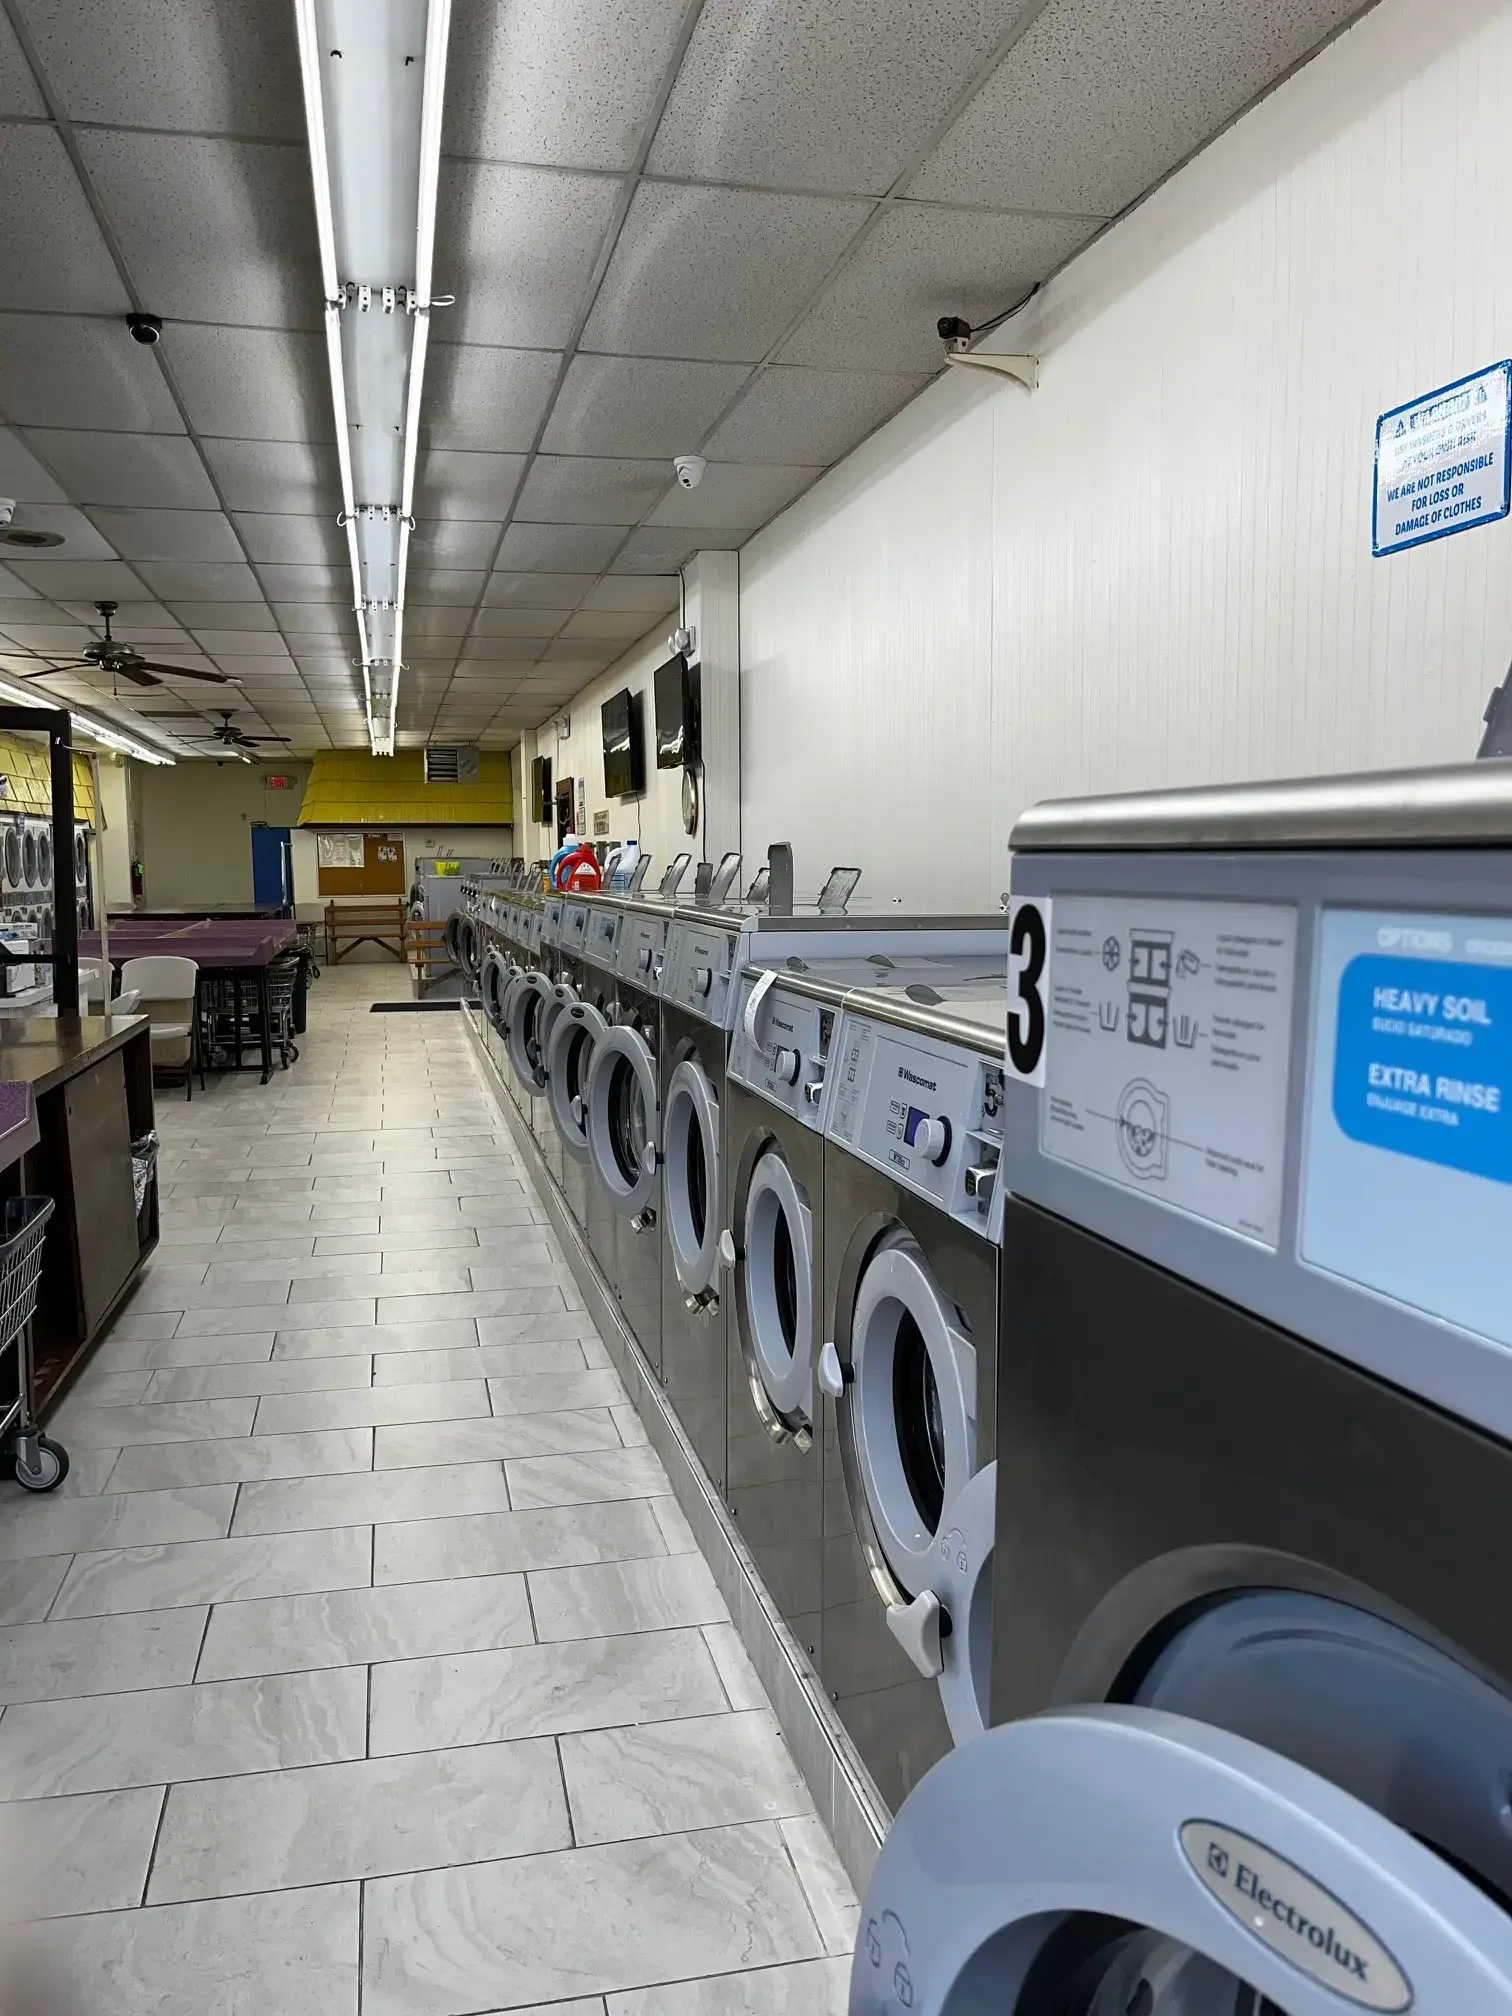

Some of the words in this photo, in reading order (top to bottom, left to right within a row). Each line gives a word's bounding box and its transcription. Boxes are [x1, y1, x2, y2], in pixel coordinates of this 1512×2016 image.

[1387, 486, 1399, 502] WE
[1400, 481, 1416, 498] ARE
[1417, 474, 1435, 494] NOT
[1436, 452, 1494, 483] RESPONSIBLE
[1412, 494, 1427, 512] FOR
[1429, 487, 1450, 508] LOSS
[1451, 483, 1464, 498] OR
[1395, 513, 1429, 536] DAMAGE
[1431, 507, 1443, 523] OF
[1443, 496, 1482, 519] CLOTHES
[1007, 904, 1046, 1075] 3
[1373, 986, 1439, 1017] HEAVY
[1442, 995, 1493, 1027] SOIL
[903, 1068, 937, 1092] Wascomat
[1368, 1062, 1431, 1097] EXTRA
[1435, 1075, 1501, 1112] RINSE
[1235, 1863, 1370, 1983] Electrolux
